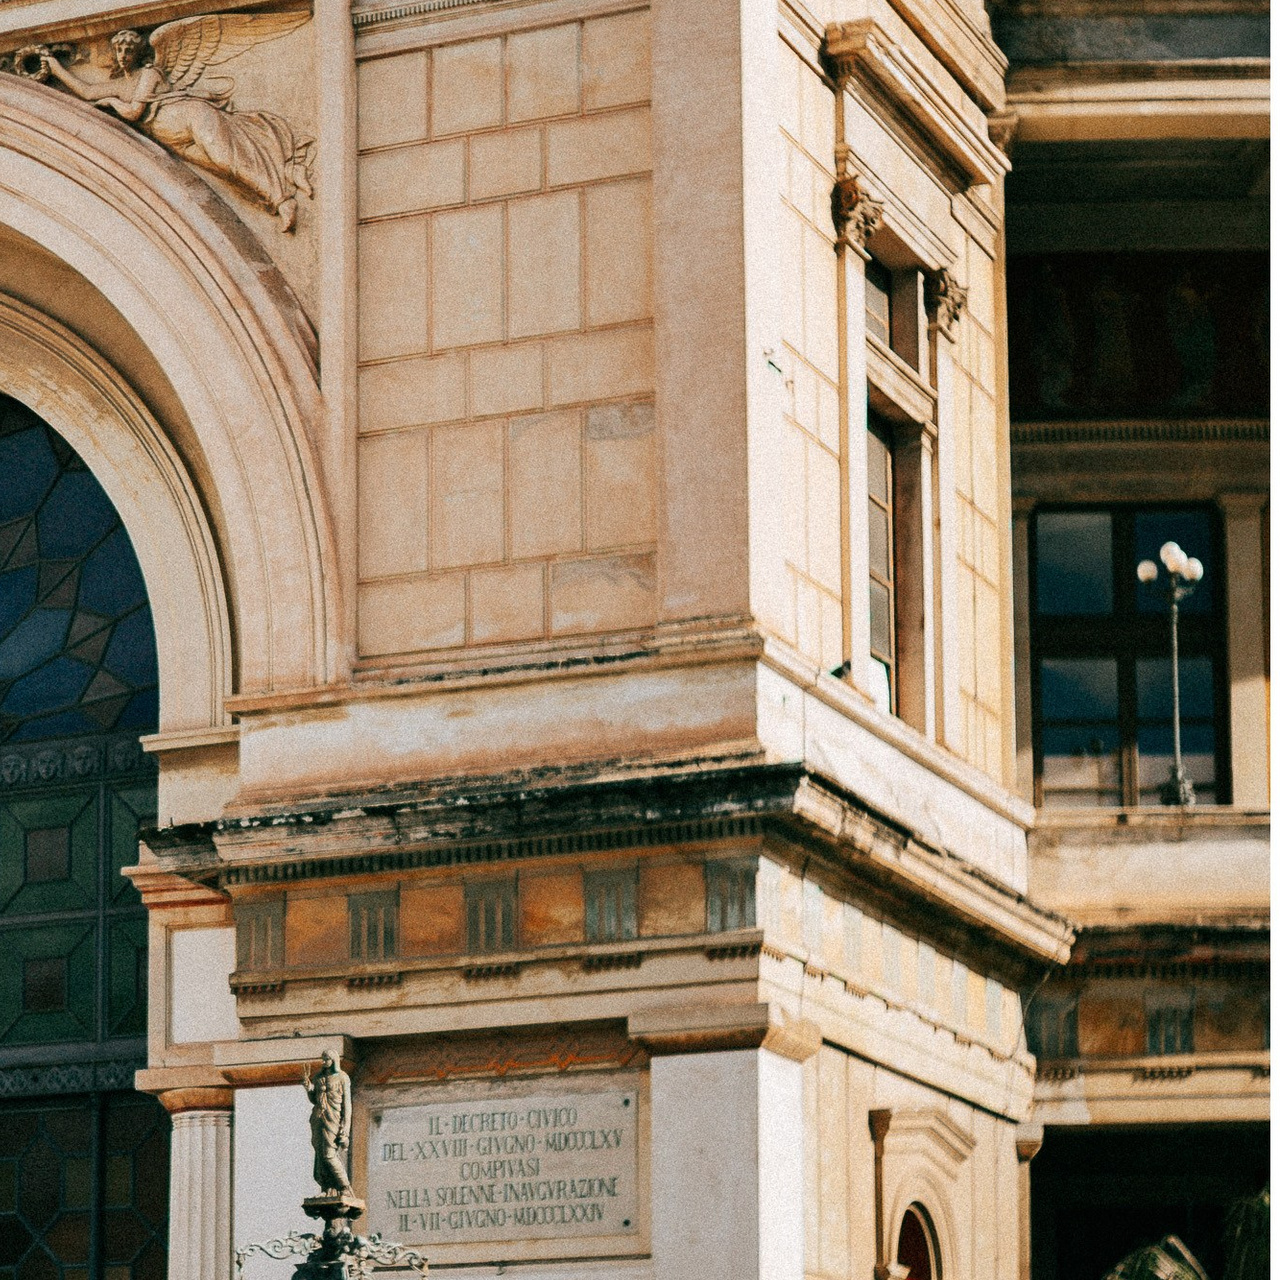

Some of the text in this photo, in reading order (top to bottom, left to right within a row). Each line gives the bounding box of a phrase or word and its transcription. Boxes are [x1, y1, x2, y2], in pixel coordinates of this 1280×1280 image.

[429, 1108, 578, 1135] IL DECRETO CIVICO
[382, 1143, 408, 1161] DEL
[386, 1189, 430, 1209] NELLA
[436, 1184, 496, 1206] SOLENNE
[398, 1214, 411, 1232] IL
